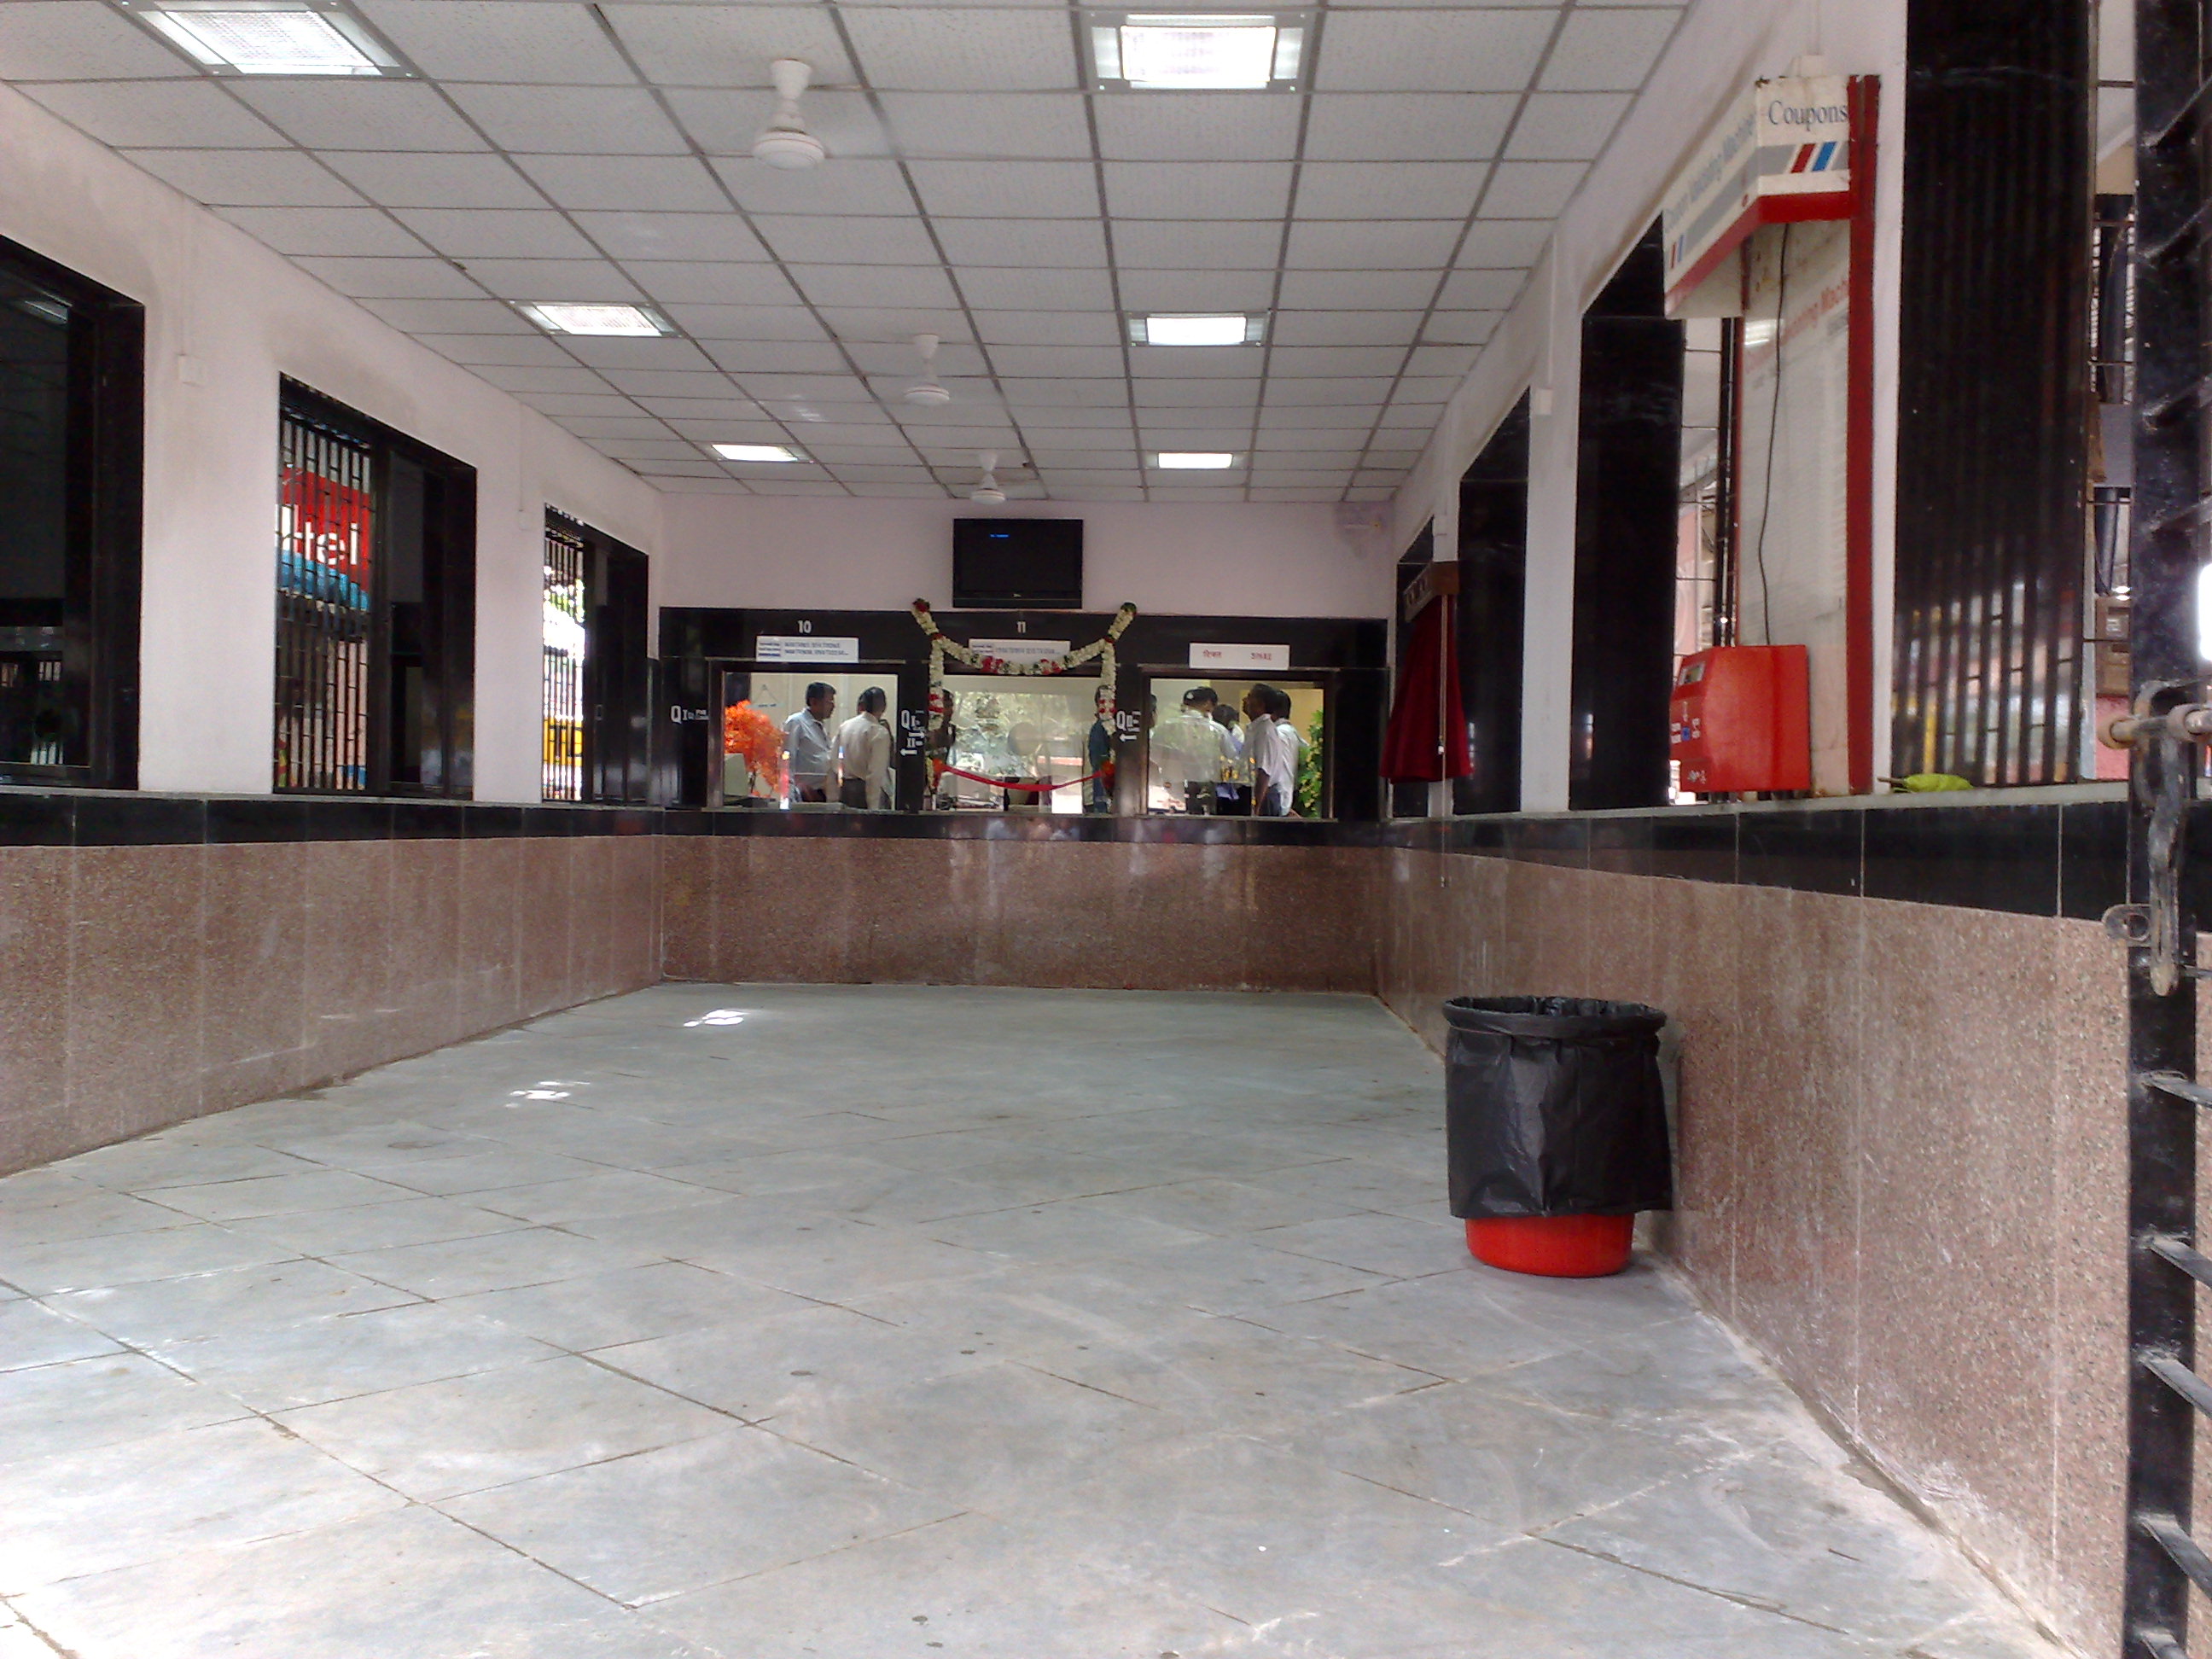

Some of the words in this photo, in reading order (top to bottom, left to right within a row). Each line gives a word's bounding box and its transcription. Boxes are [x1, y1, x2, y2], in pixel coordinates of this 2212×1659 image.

[1768, 100, 1848, 131] Coupons
[797, 620, 812, 634] 10
[1016, 620, 1027, 633] 11
